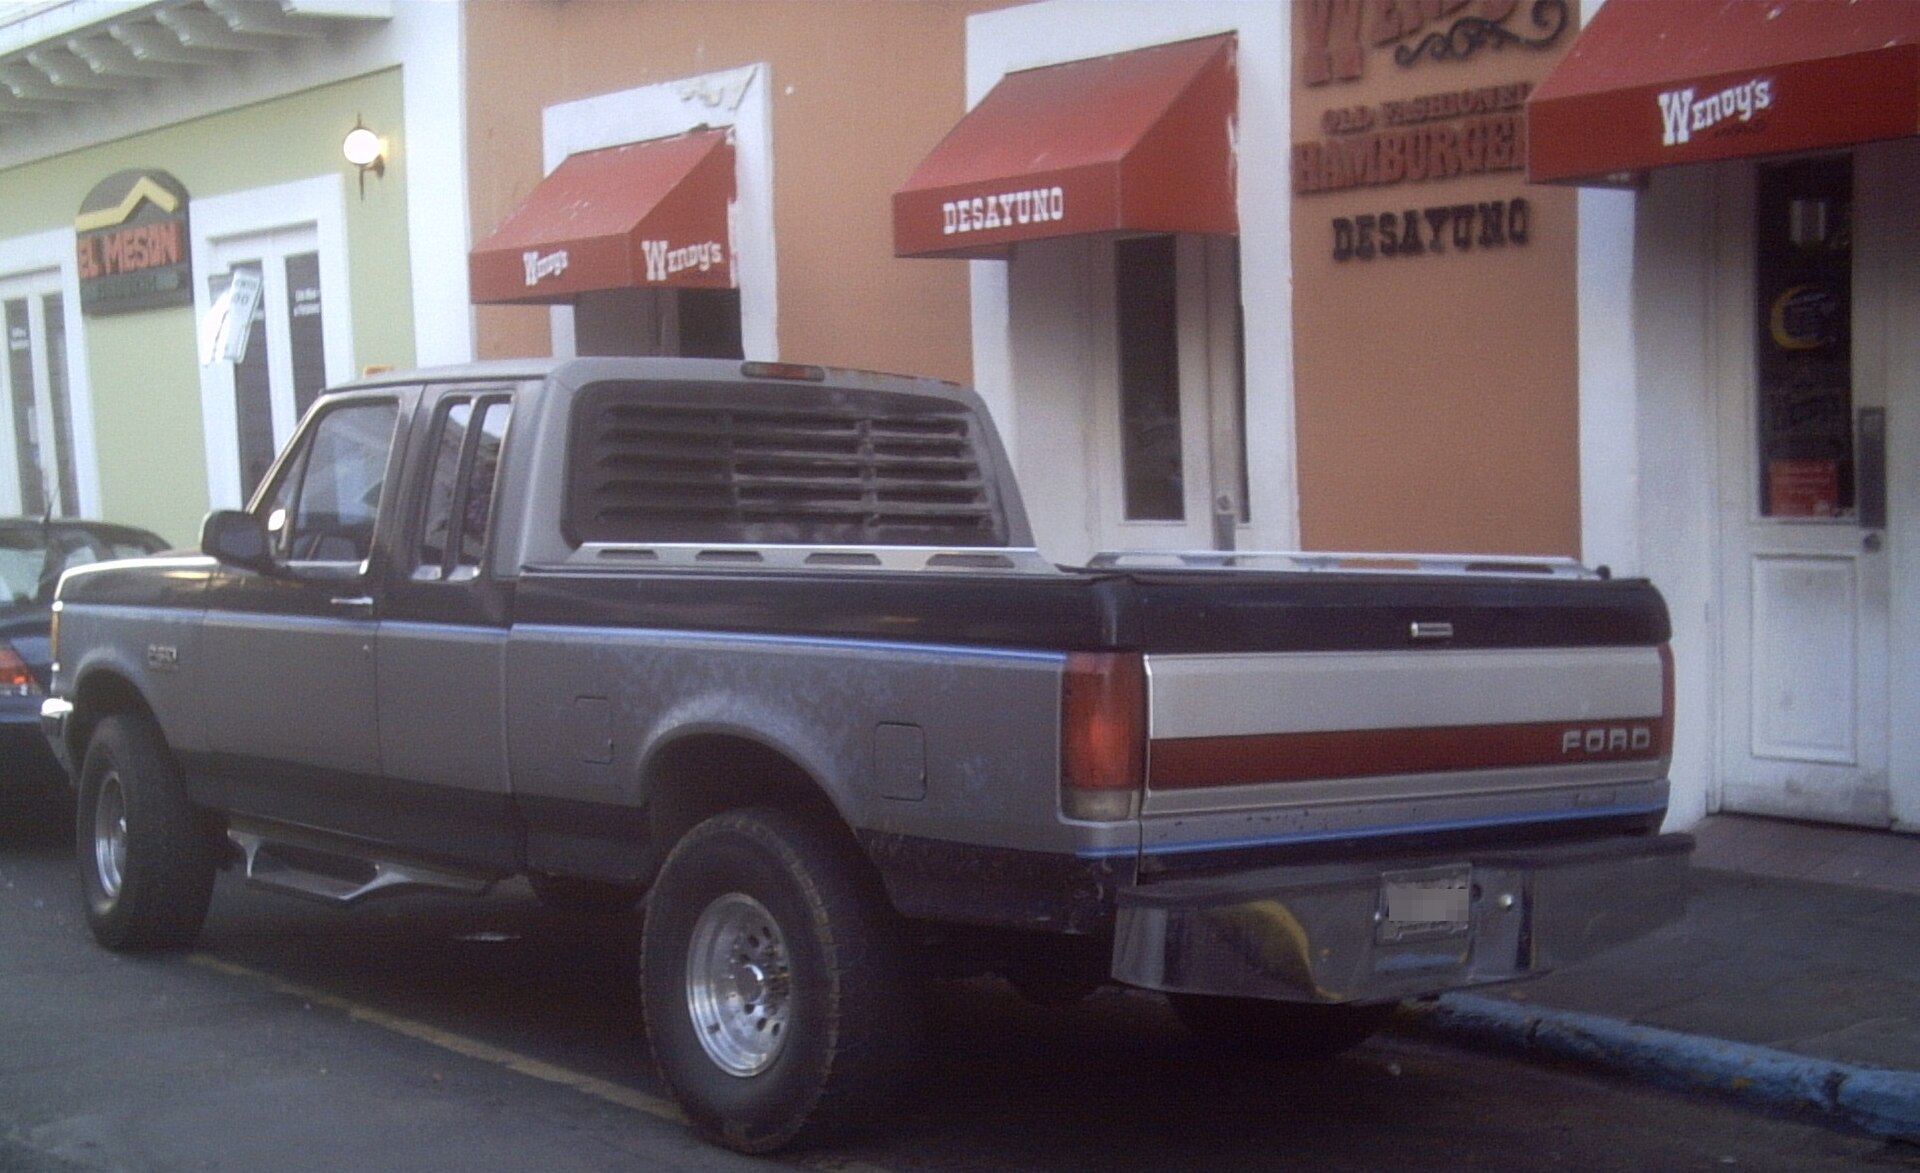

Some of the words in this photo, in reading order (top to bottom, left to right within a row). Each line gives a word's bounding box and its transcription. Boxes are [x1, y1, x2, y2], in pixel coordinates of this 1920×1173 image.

[1321, 105, 1377, 135] OLD
[943, 186, 1063, 234] DESAYUNO
[1332, 198, 1530, 262] DESAYUNO
[78, 236, 100, 279] EL
[1562, 727, 1651, 754] FORD
